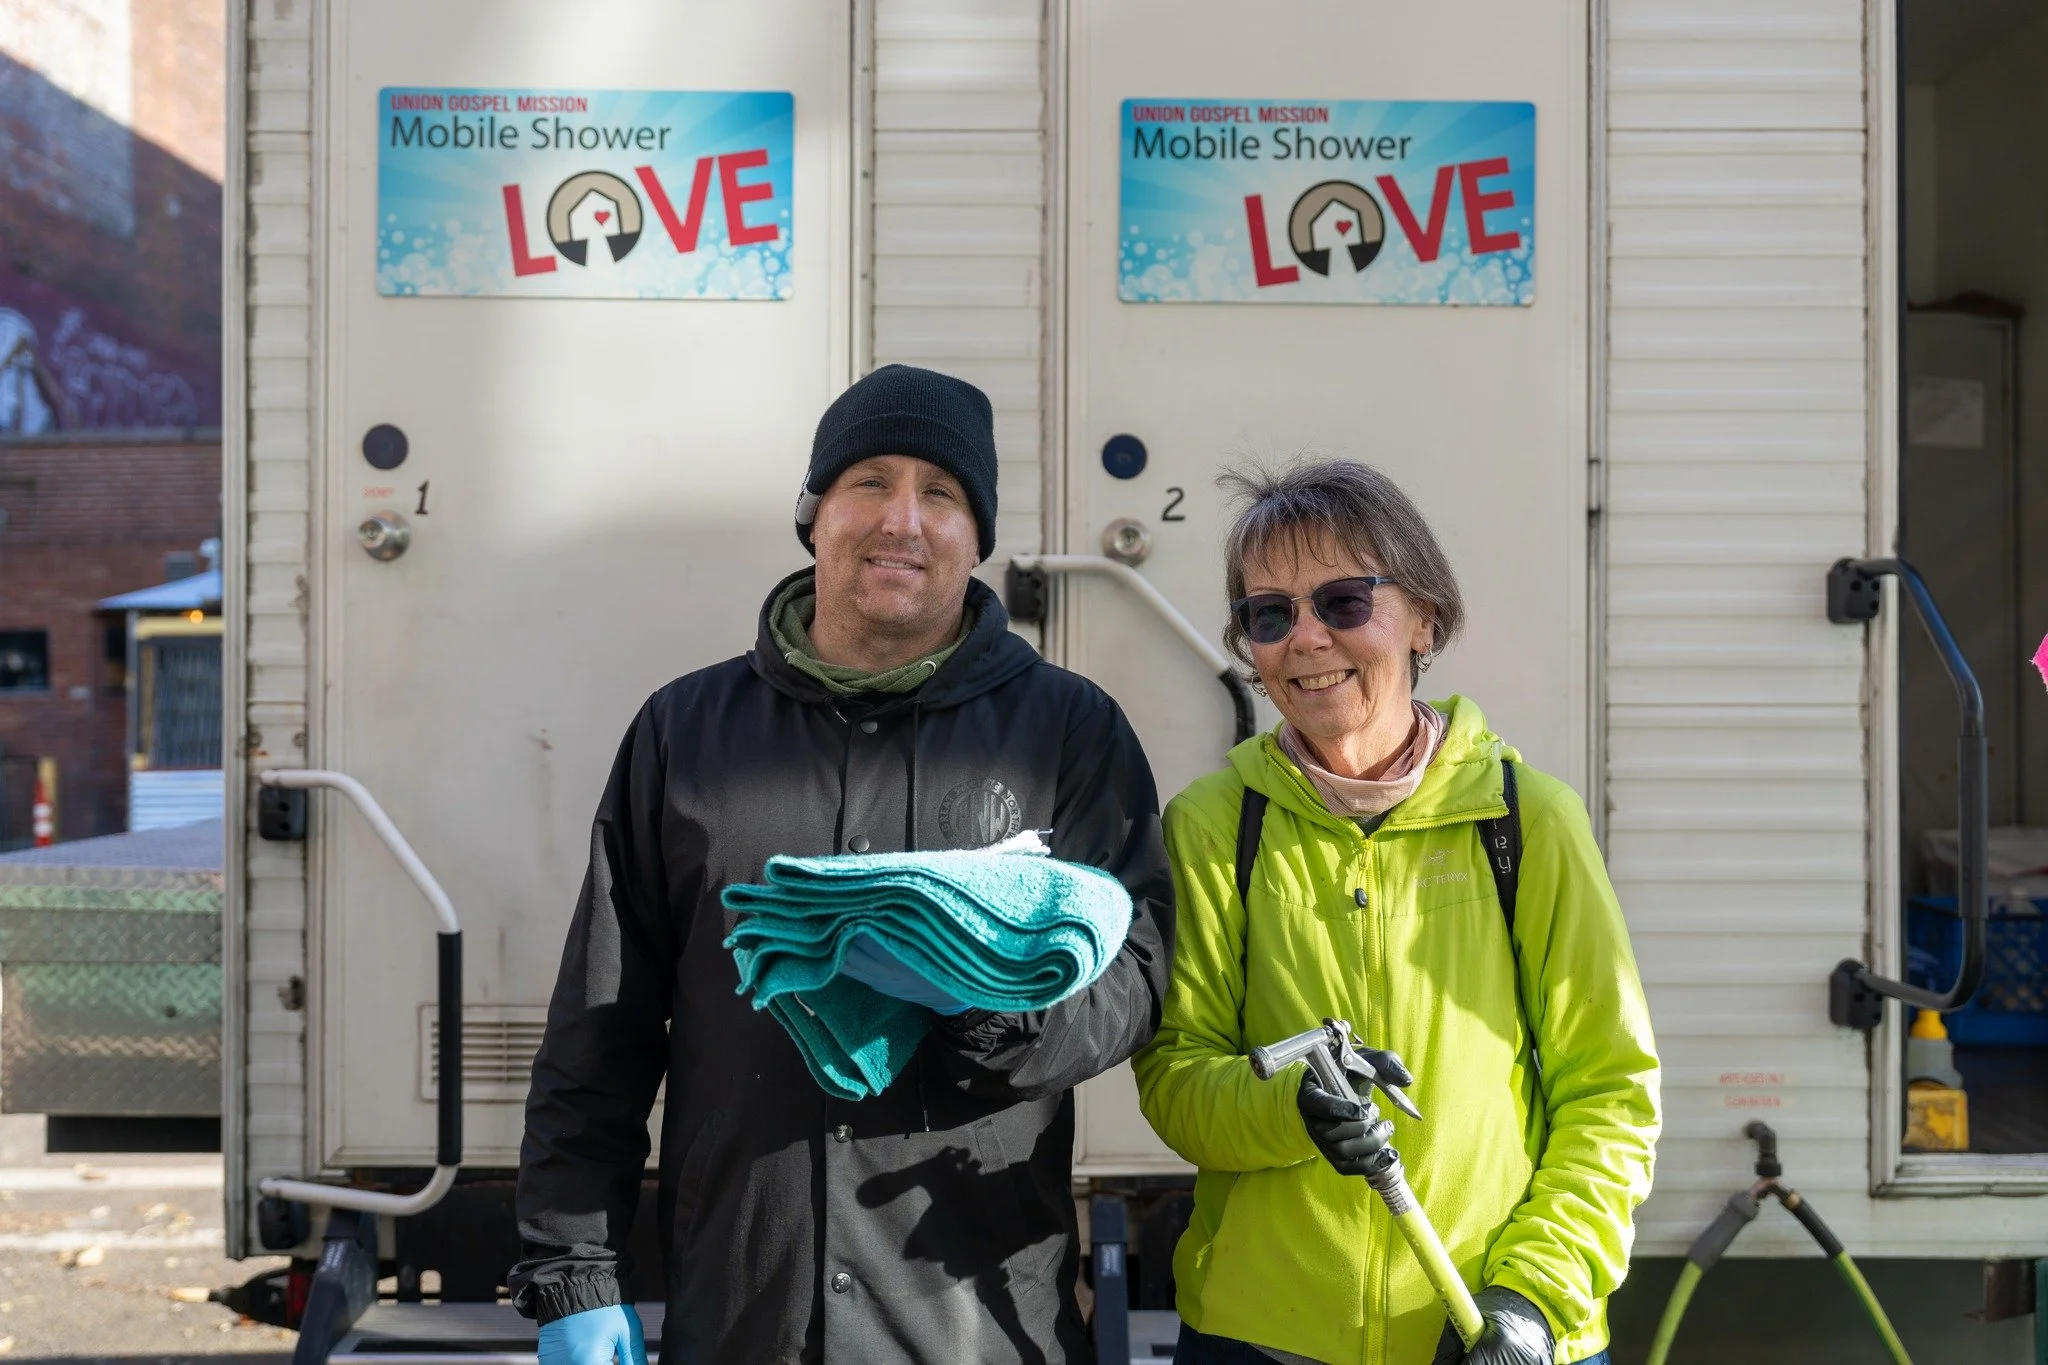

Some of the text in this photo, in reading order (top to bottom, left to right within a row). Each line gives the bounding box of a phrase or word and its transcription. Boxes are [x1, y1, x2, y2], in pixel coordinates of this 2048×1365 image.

[391, 95, 588, 113] UNION GOSPEL MISSION
[1133, 106, 1329, 124] UNION GOSPEL MISSION
[391, 115, 671, 151] Mobile Shower
[1133, 126, 1412, 161] Mobile Shower
[502, 149, 780, 278] LOVE
[1244, 156, 1521, 288] LOVE
[415, 479, 430, 516] 1
[1161, 486, 1186, 522] 2
